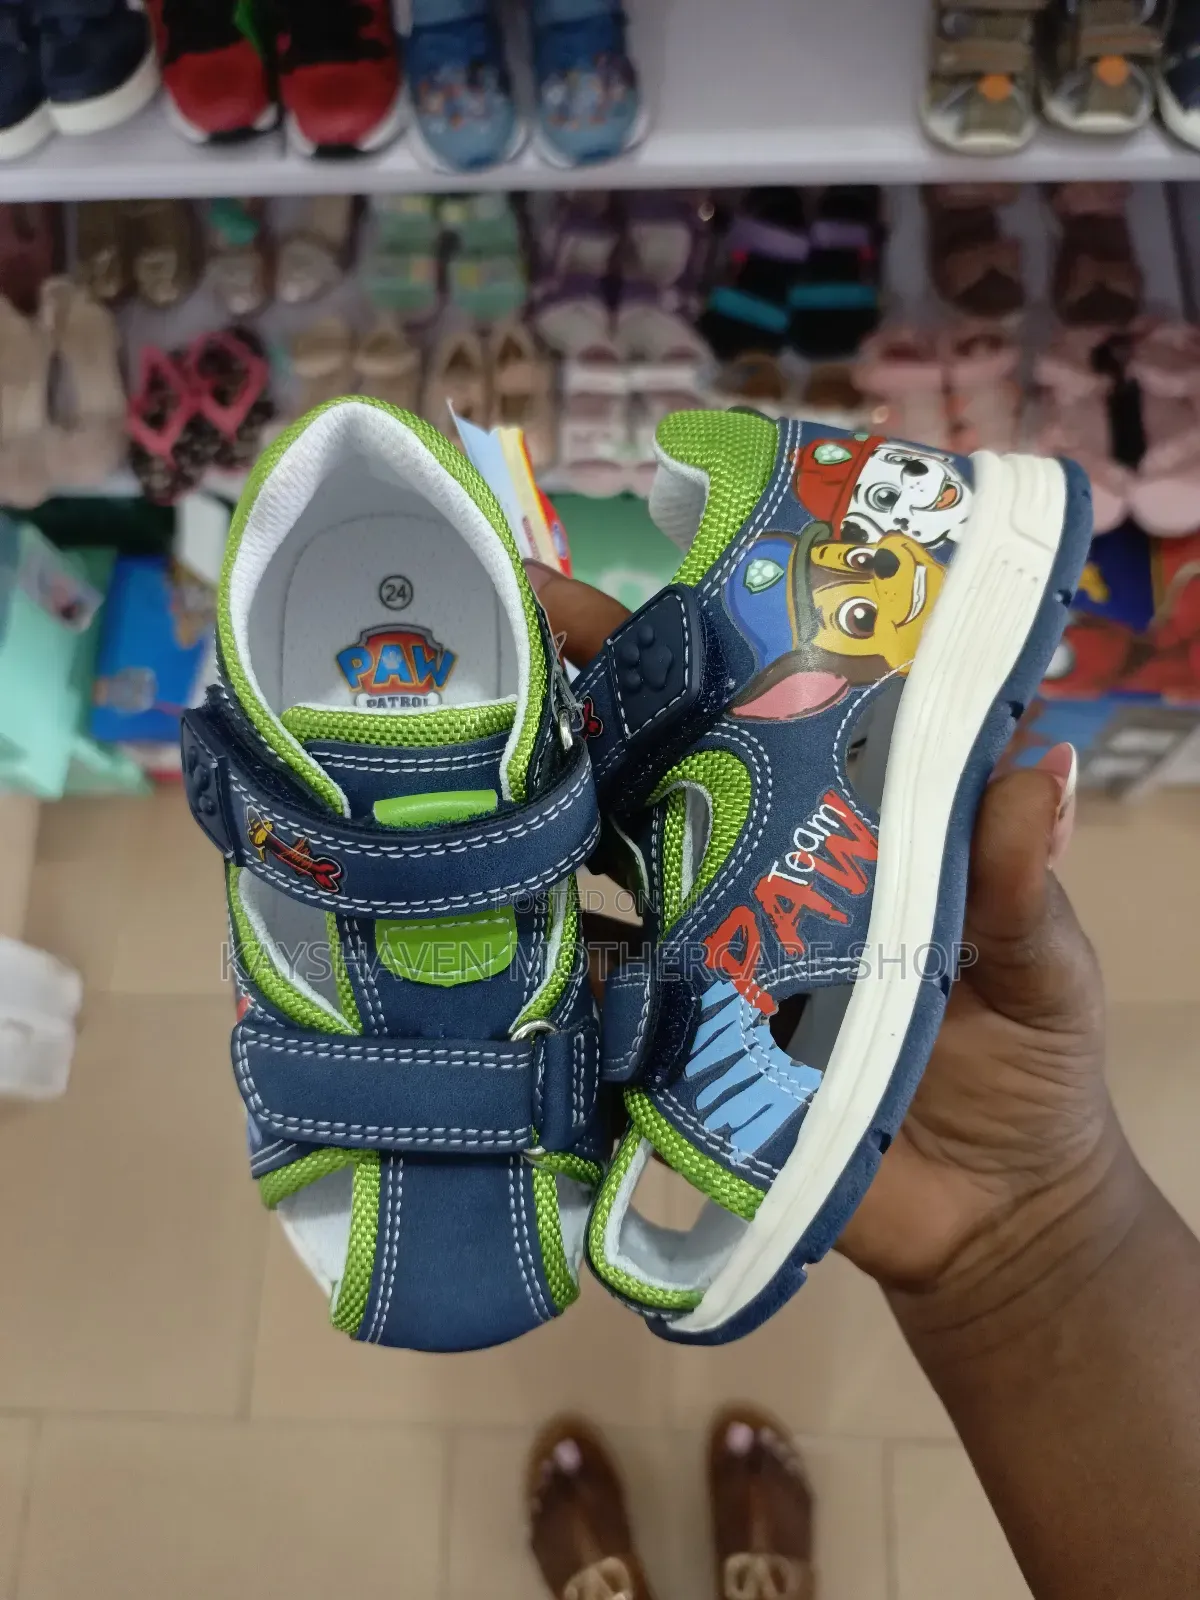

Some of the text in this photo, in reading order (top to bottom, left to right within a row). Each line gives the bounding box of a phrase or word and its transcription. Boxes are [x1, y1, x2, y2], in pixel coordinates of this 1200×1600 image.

[385, 584, 407, 602] 24
[334, 643, 458, 692] PAW
[767, 803, 847, 886] Team
[703, 789, 879, 1016] PAW
